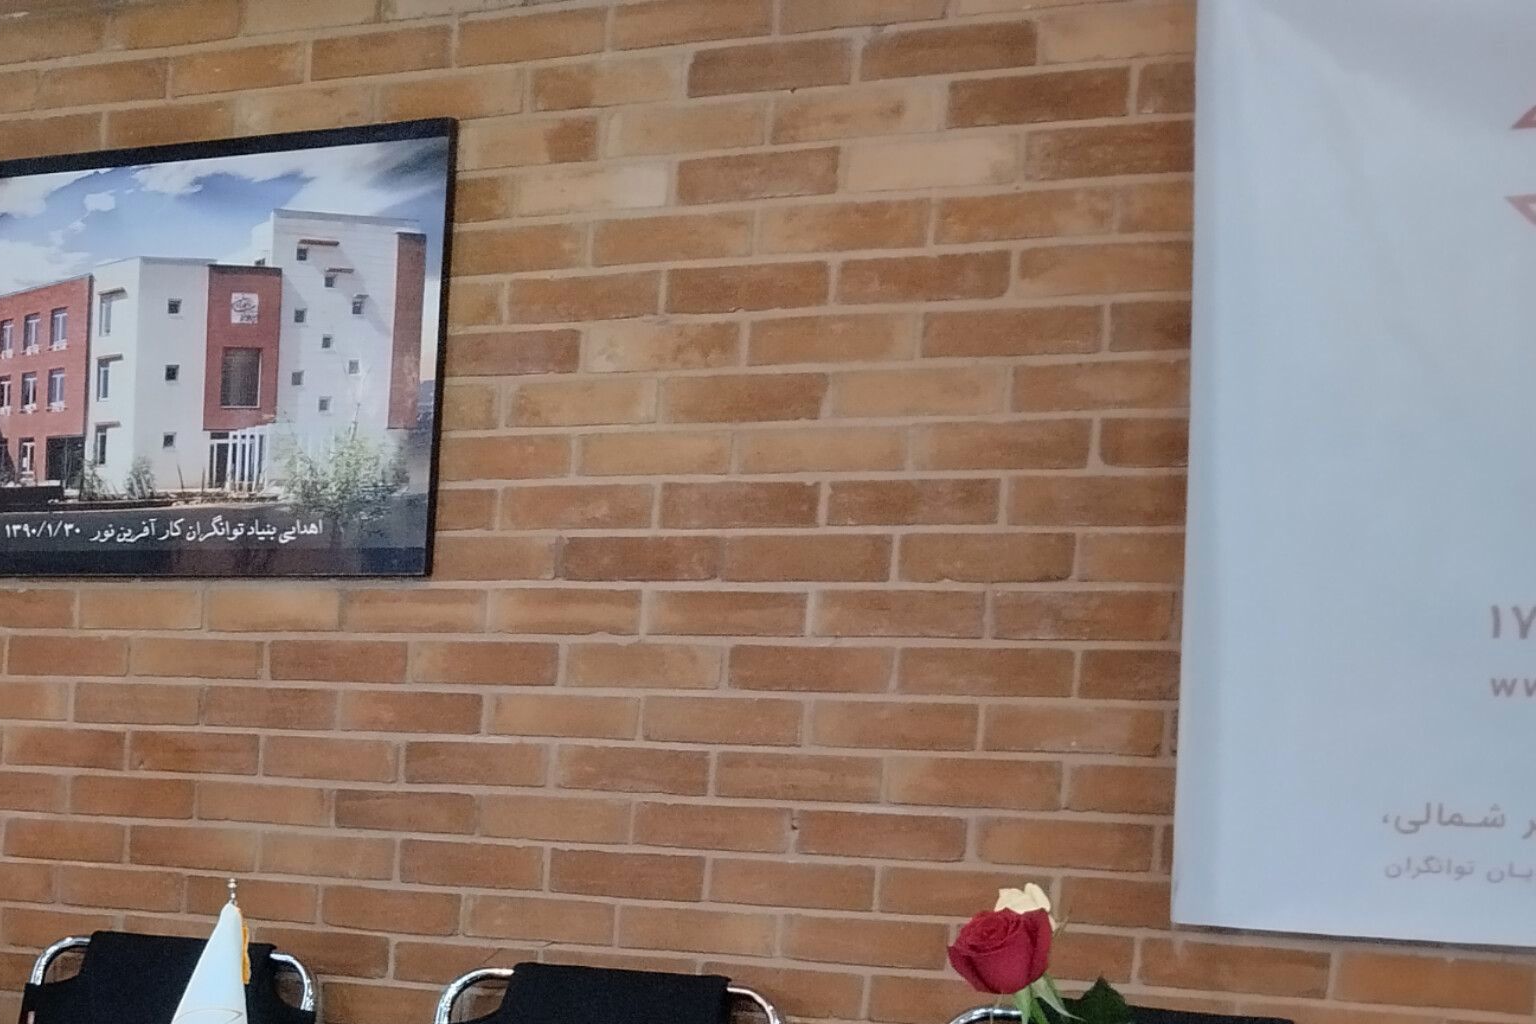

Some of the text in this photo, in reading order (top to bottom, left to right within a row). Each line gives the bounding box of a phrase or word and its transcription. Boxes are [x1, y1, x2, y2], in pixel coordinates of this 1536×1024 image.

[89, 523, 115, 543] نور
[186, 514, 244, 542] توانگران
[247, 518, 277, 541] بنیاد
[1384, 855, 1475, 881] توانگران
